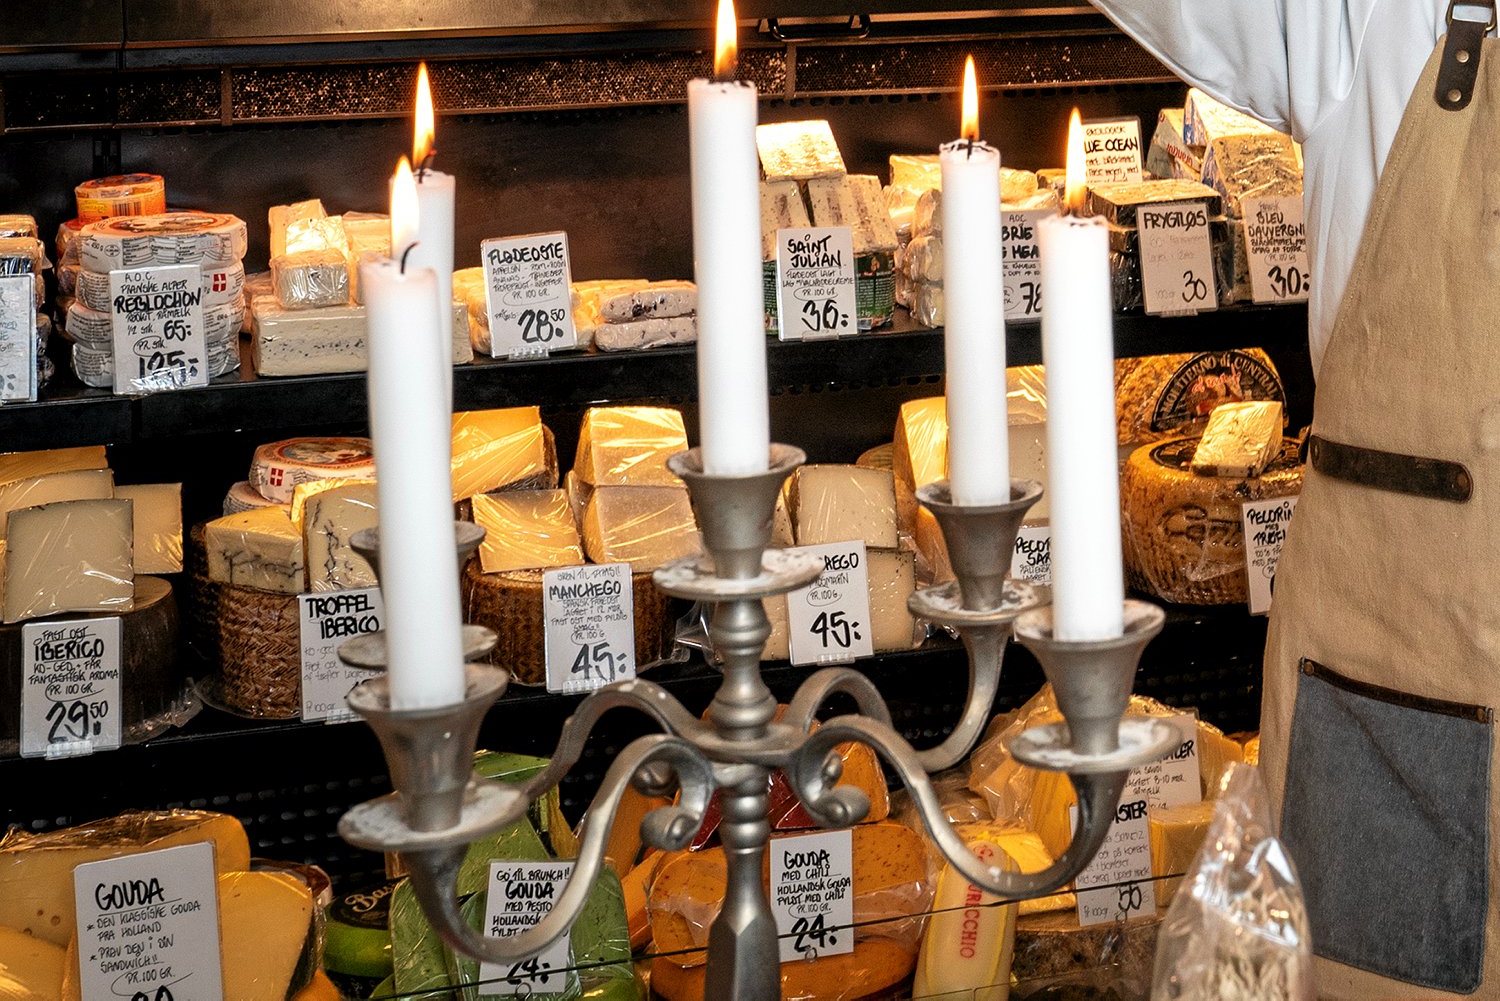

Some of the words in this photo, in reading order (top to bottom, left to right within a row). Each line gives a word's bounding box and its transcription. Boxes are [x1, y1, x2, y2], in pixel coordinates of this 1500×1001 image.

[1105, 136, 1138, 151] OCEAN
[1144, 210, 1206, 231] FRYGTLØS
[1256, 212, 1284, 224] BLEU
[1002, 223, 1033, 241] BRIE
[787, 234, 832, 254] SAINT
[487, 242, 564, 266] FLØDEOSTE
[790, 250, 842, 268] JULIAN
[526, 289, 536, 298] 100
[1182, 270, 1207, 302] 30
[114, 288, 201, 313] REBLOCHON
[549, 580, 621, 600] MANCHEGO
[42, 629, 67, 641] FAST
[69, 625, 89, 638] OST
[320, 615, 380, 639] IBERICO
[33, 638, 105, 662] IBERICO
[89, 669, 119, 681] AROMA
[66, 685, 79, 695] 100
[90, 701, 109, 718] 50
[784, 849, 830, 869] GOUDA
[513, 868, 526, 881] TIL
[782, 870, 801, 882] MED
[806, 864, 830, 879] CHILI
[94, 877, 165, 910] GOUDA
[505, 880, 555, 899] GOUDA
[777, 879, 826, 896] HOLLANDSK
[827, 877, 851, 892] GOUDA
[805, 893, 821, 903] MED
[825, 888, 846, 901] CHILI
[97, 914, 116, 929] DEN
[120, 905, 166, 925] KLASSISKE
[170, 900, 201, 916] GOUDA
[505, 902, 523, 912] MED
[526, 901, 552, 912] PESTO
[807, 904, 818, 913] 100
[492, 913, 540, 925] HOLLANDSK
[959, 884, 984, 959] URICCHIO
[97, 928, 115, 941] FRA
[121, 924, 162, 938] HOLLAND
[142, 970, 157, 982] 100
